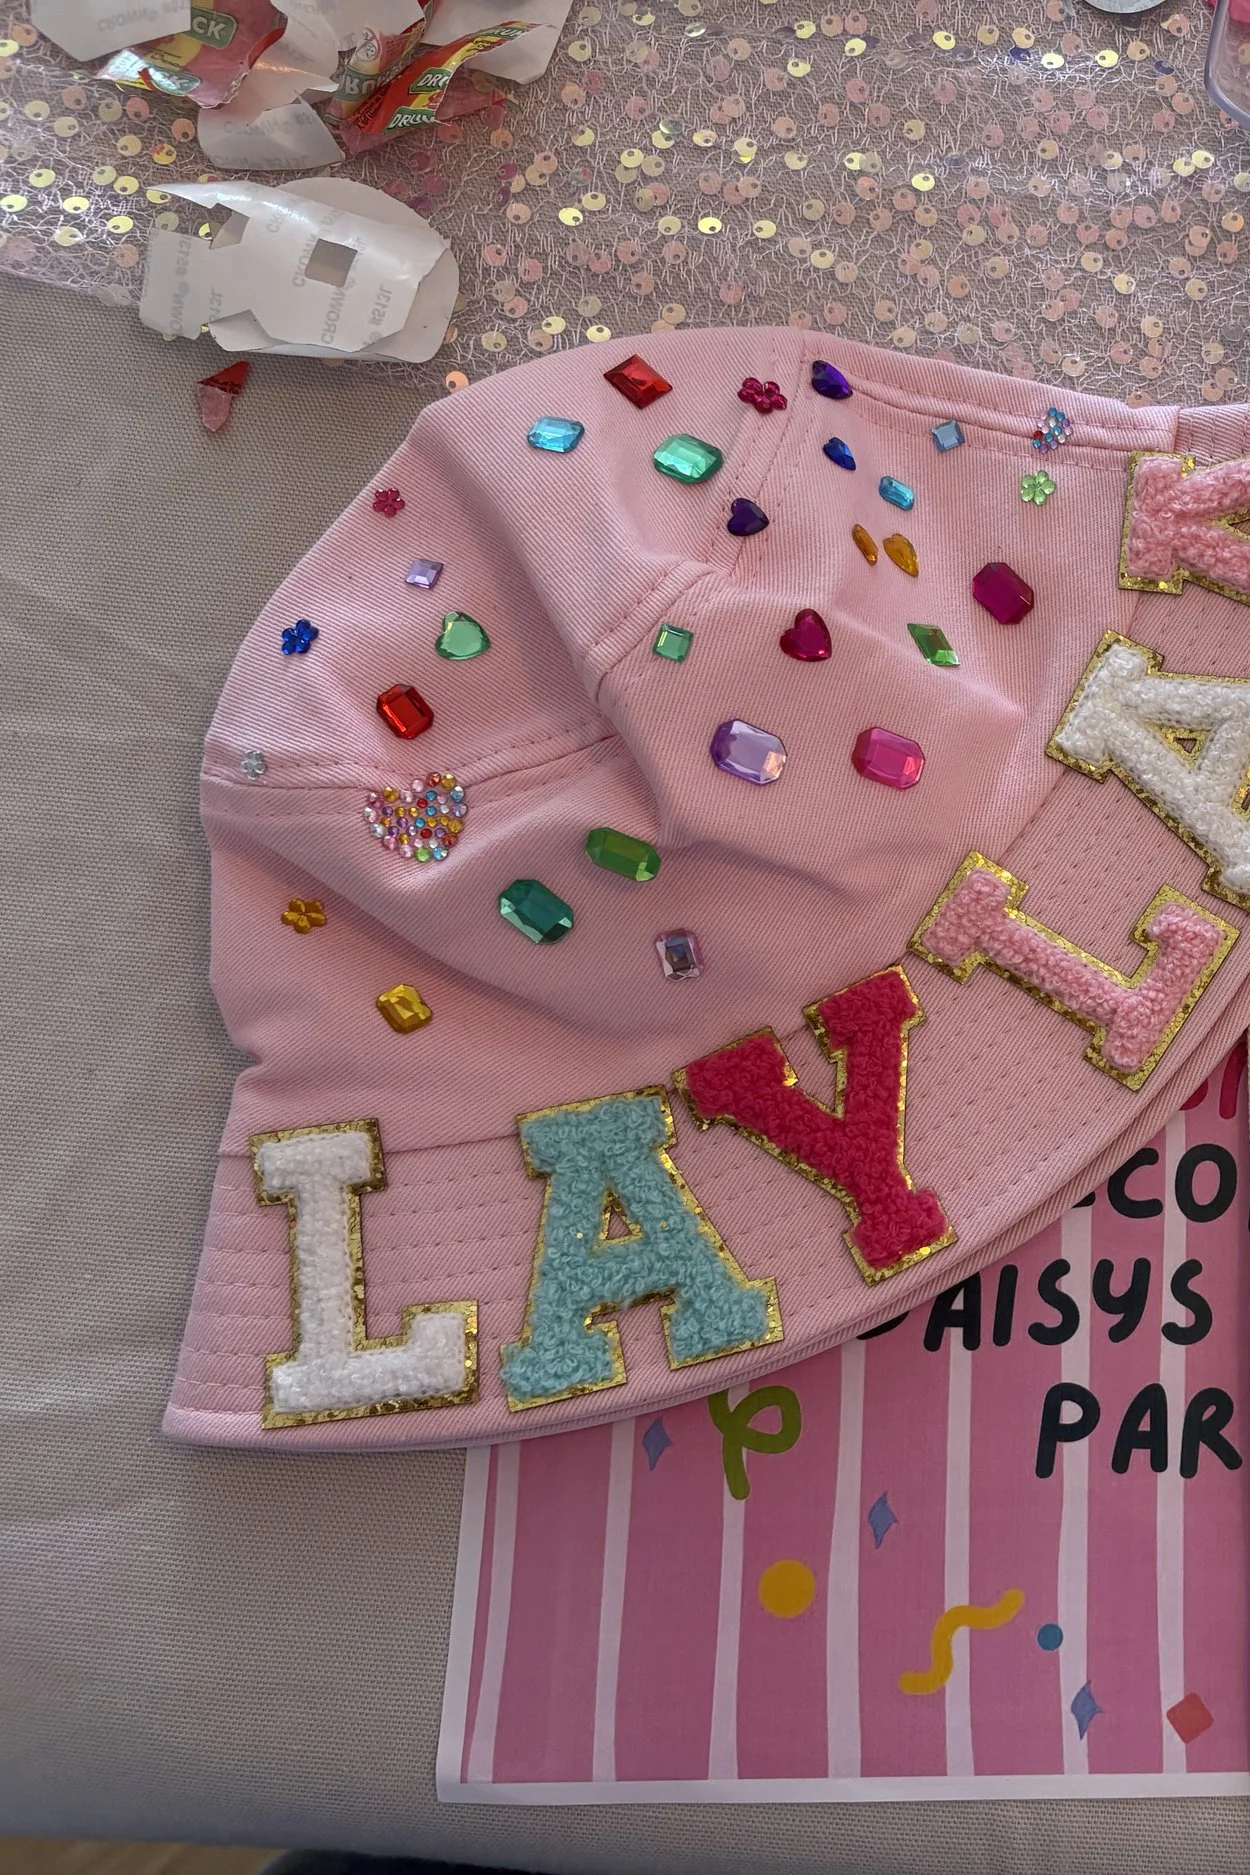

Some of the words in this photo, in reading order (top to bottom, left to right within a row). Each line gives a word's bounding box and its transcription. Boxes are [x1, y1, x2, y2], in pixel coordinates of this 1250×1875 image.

[1072, 1143, 1238, 1223] CO
[855, 1257, 1213, 1352] AISYS
[1035, 1382, 1243, 1479] PAR
